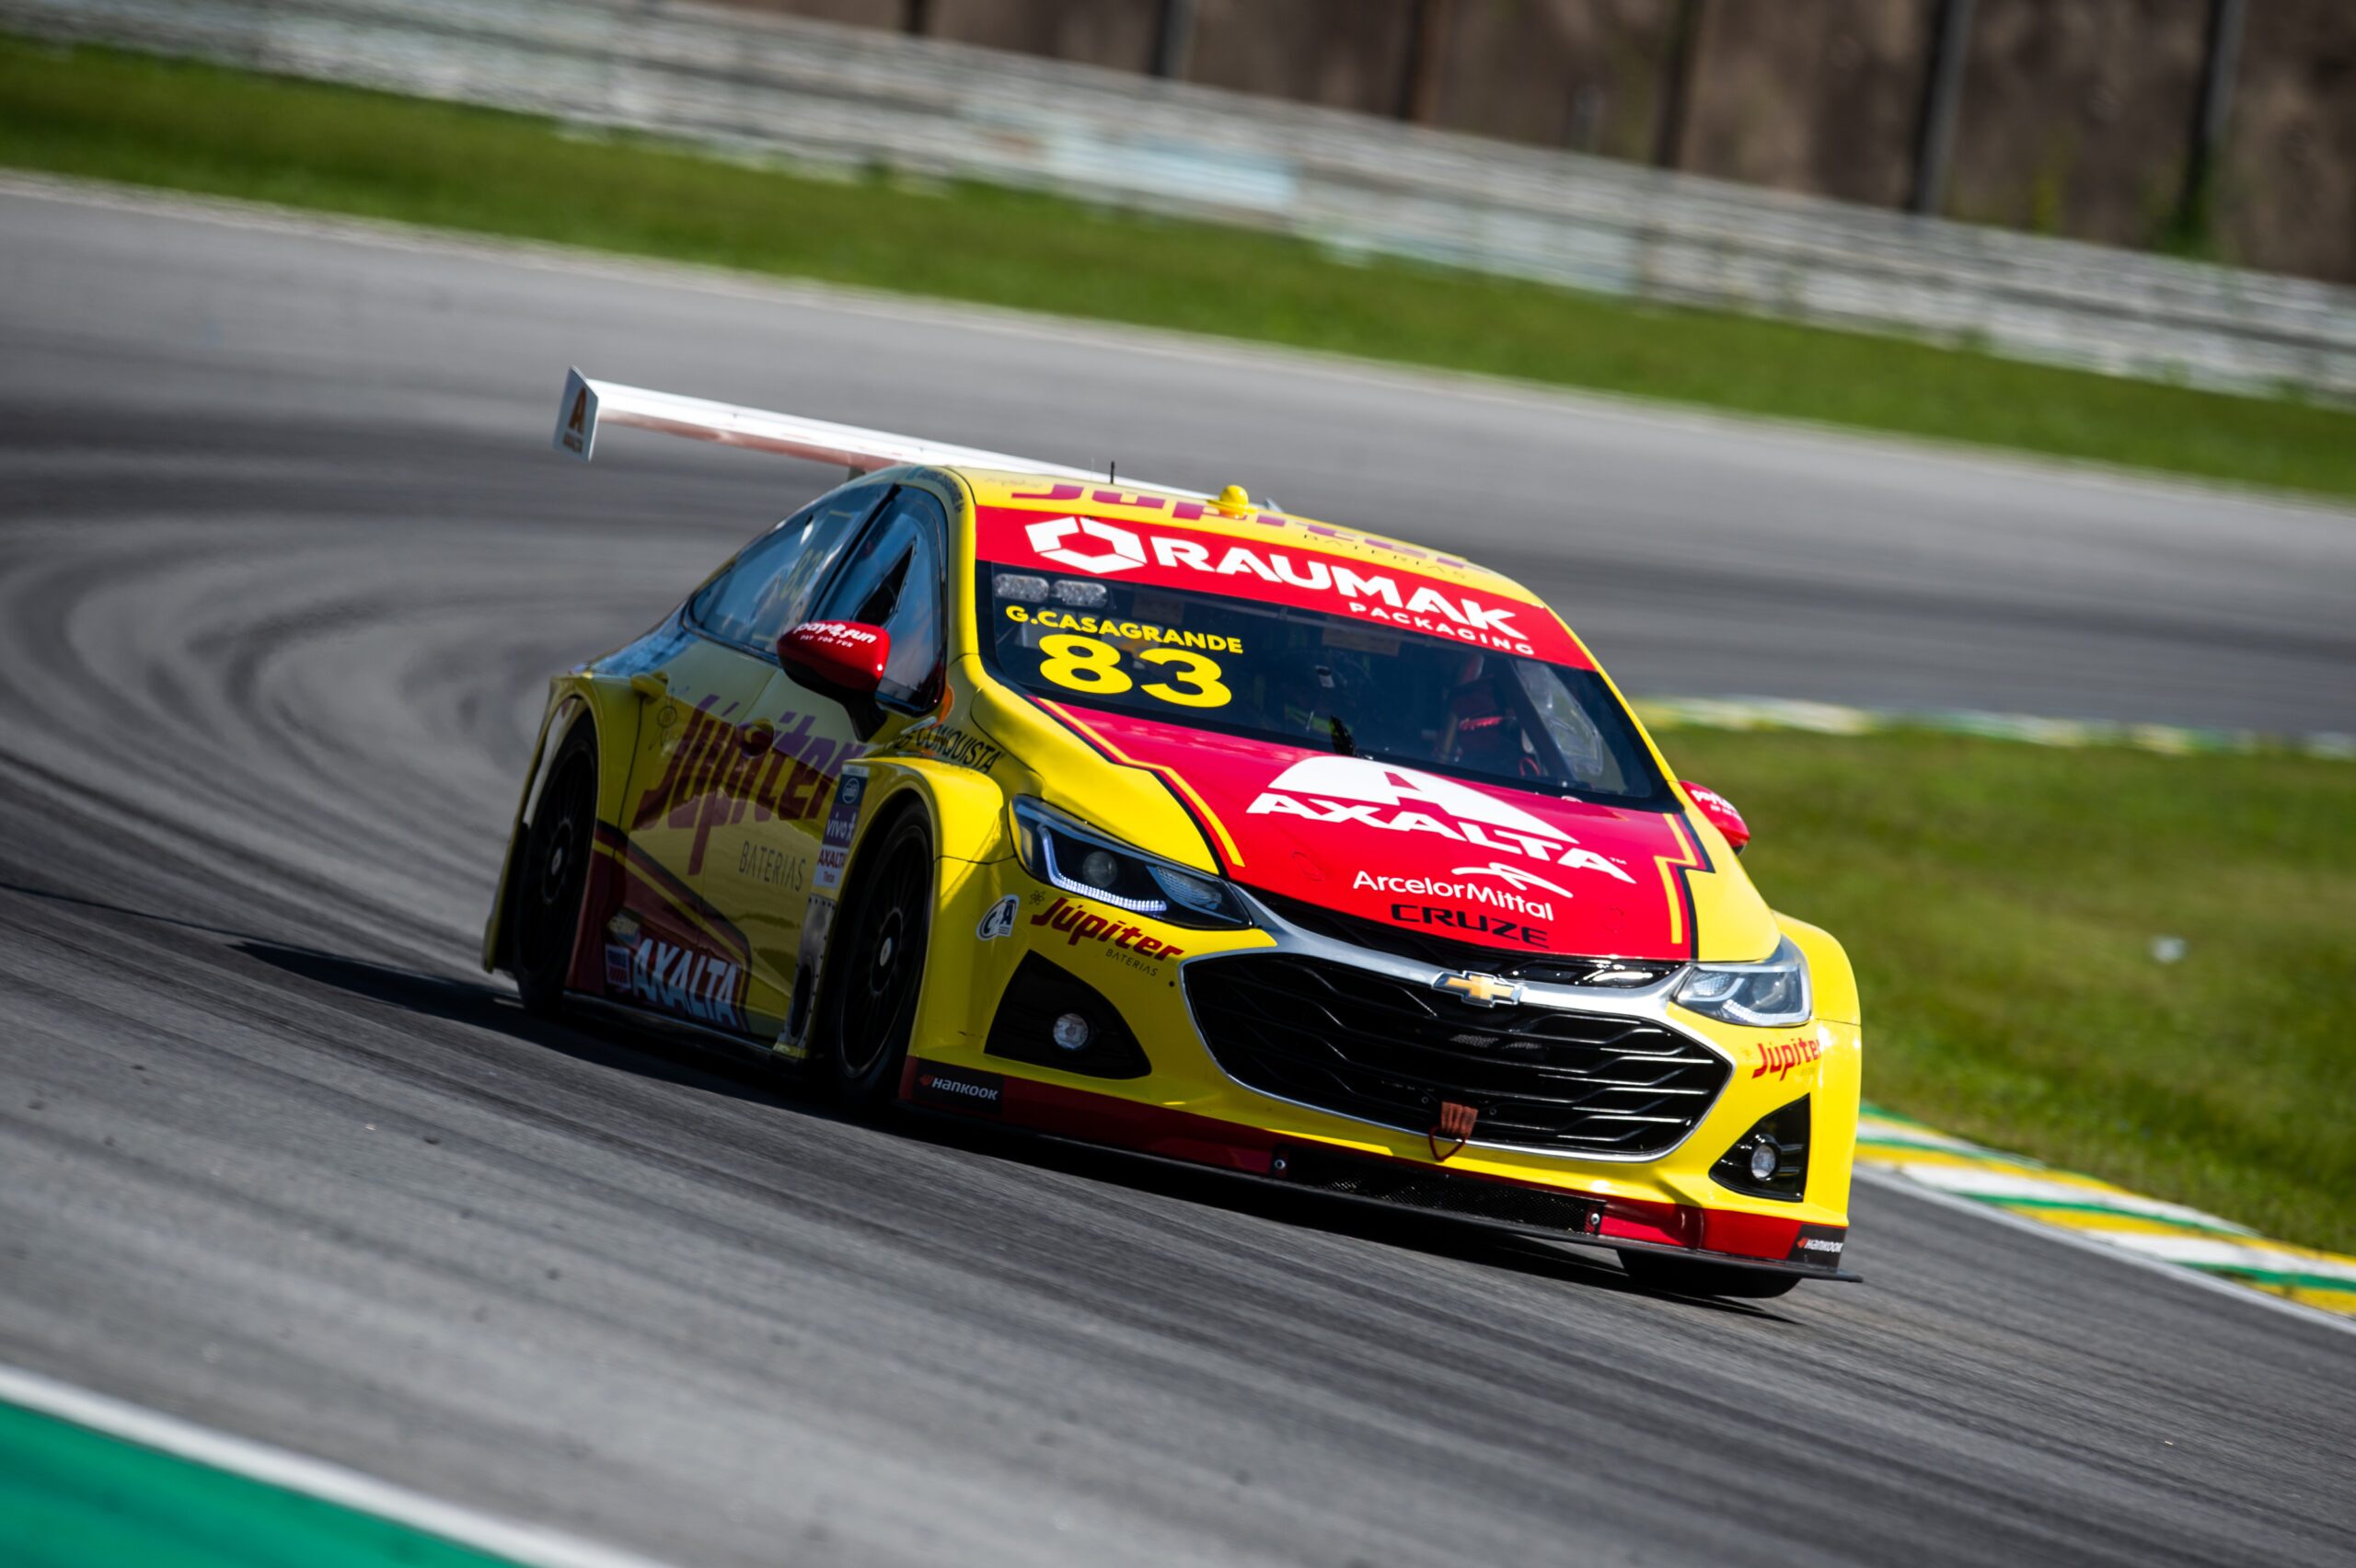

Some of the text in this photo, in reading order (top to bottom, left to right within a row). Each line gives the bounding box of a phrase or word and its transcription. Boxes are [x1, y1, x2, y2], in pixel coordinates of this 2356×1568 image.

[1149, 536, 1530, 641] RAUMAK
[1006, 605, 1243, 654] G.CASAGRANDE
[1349, 603, 1534, 655] PACKAGING
[1039, 634, 1231, 708] 83
[1246, 792, 1636, 883] AXALTA
[739, 840, 806, 894] BATERIAS
[1353, 870, 1553, 921] ArcelorMittal
[1391, 904, 1550, 949] CRUZE
[632, 938, 740, 1027] AXALTA
[1106, 948, 1159, 977] BATERIAS
